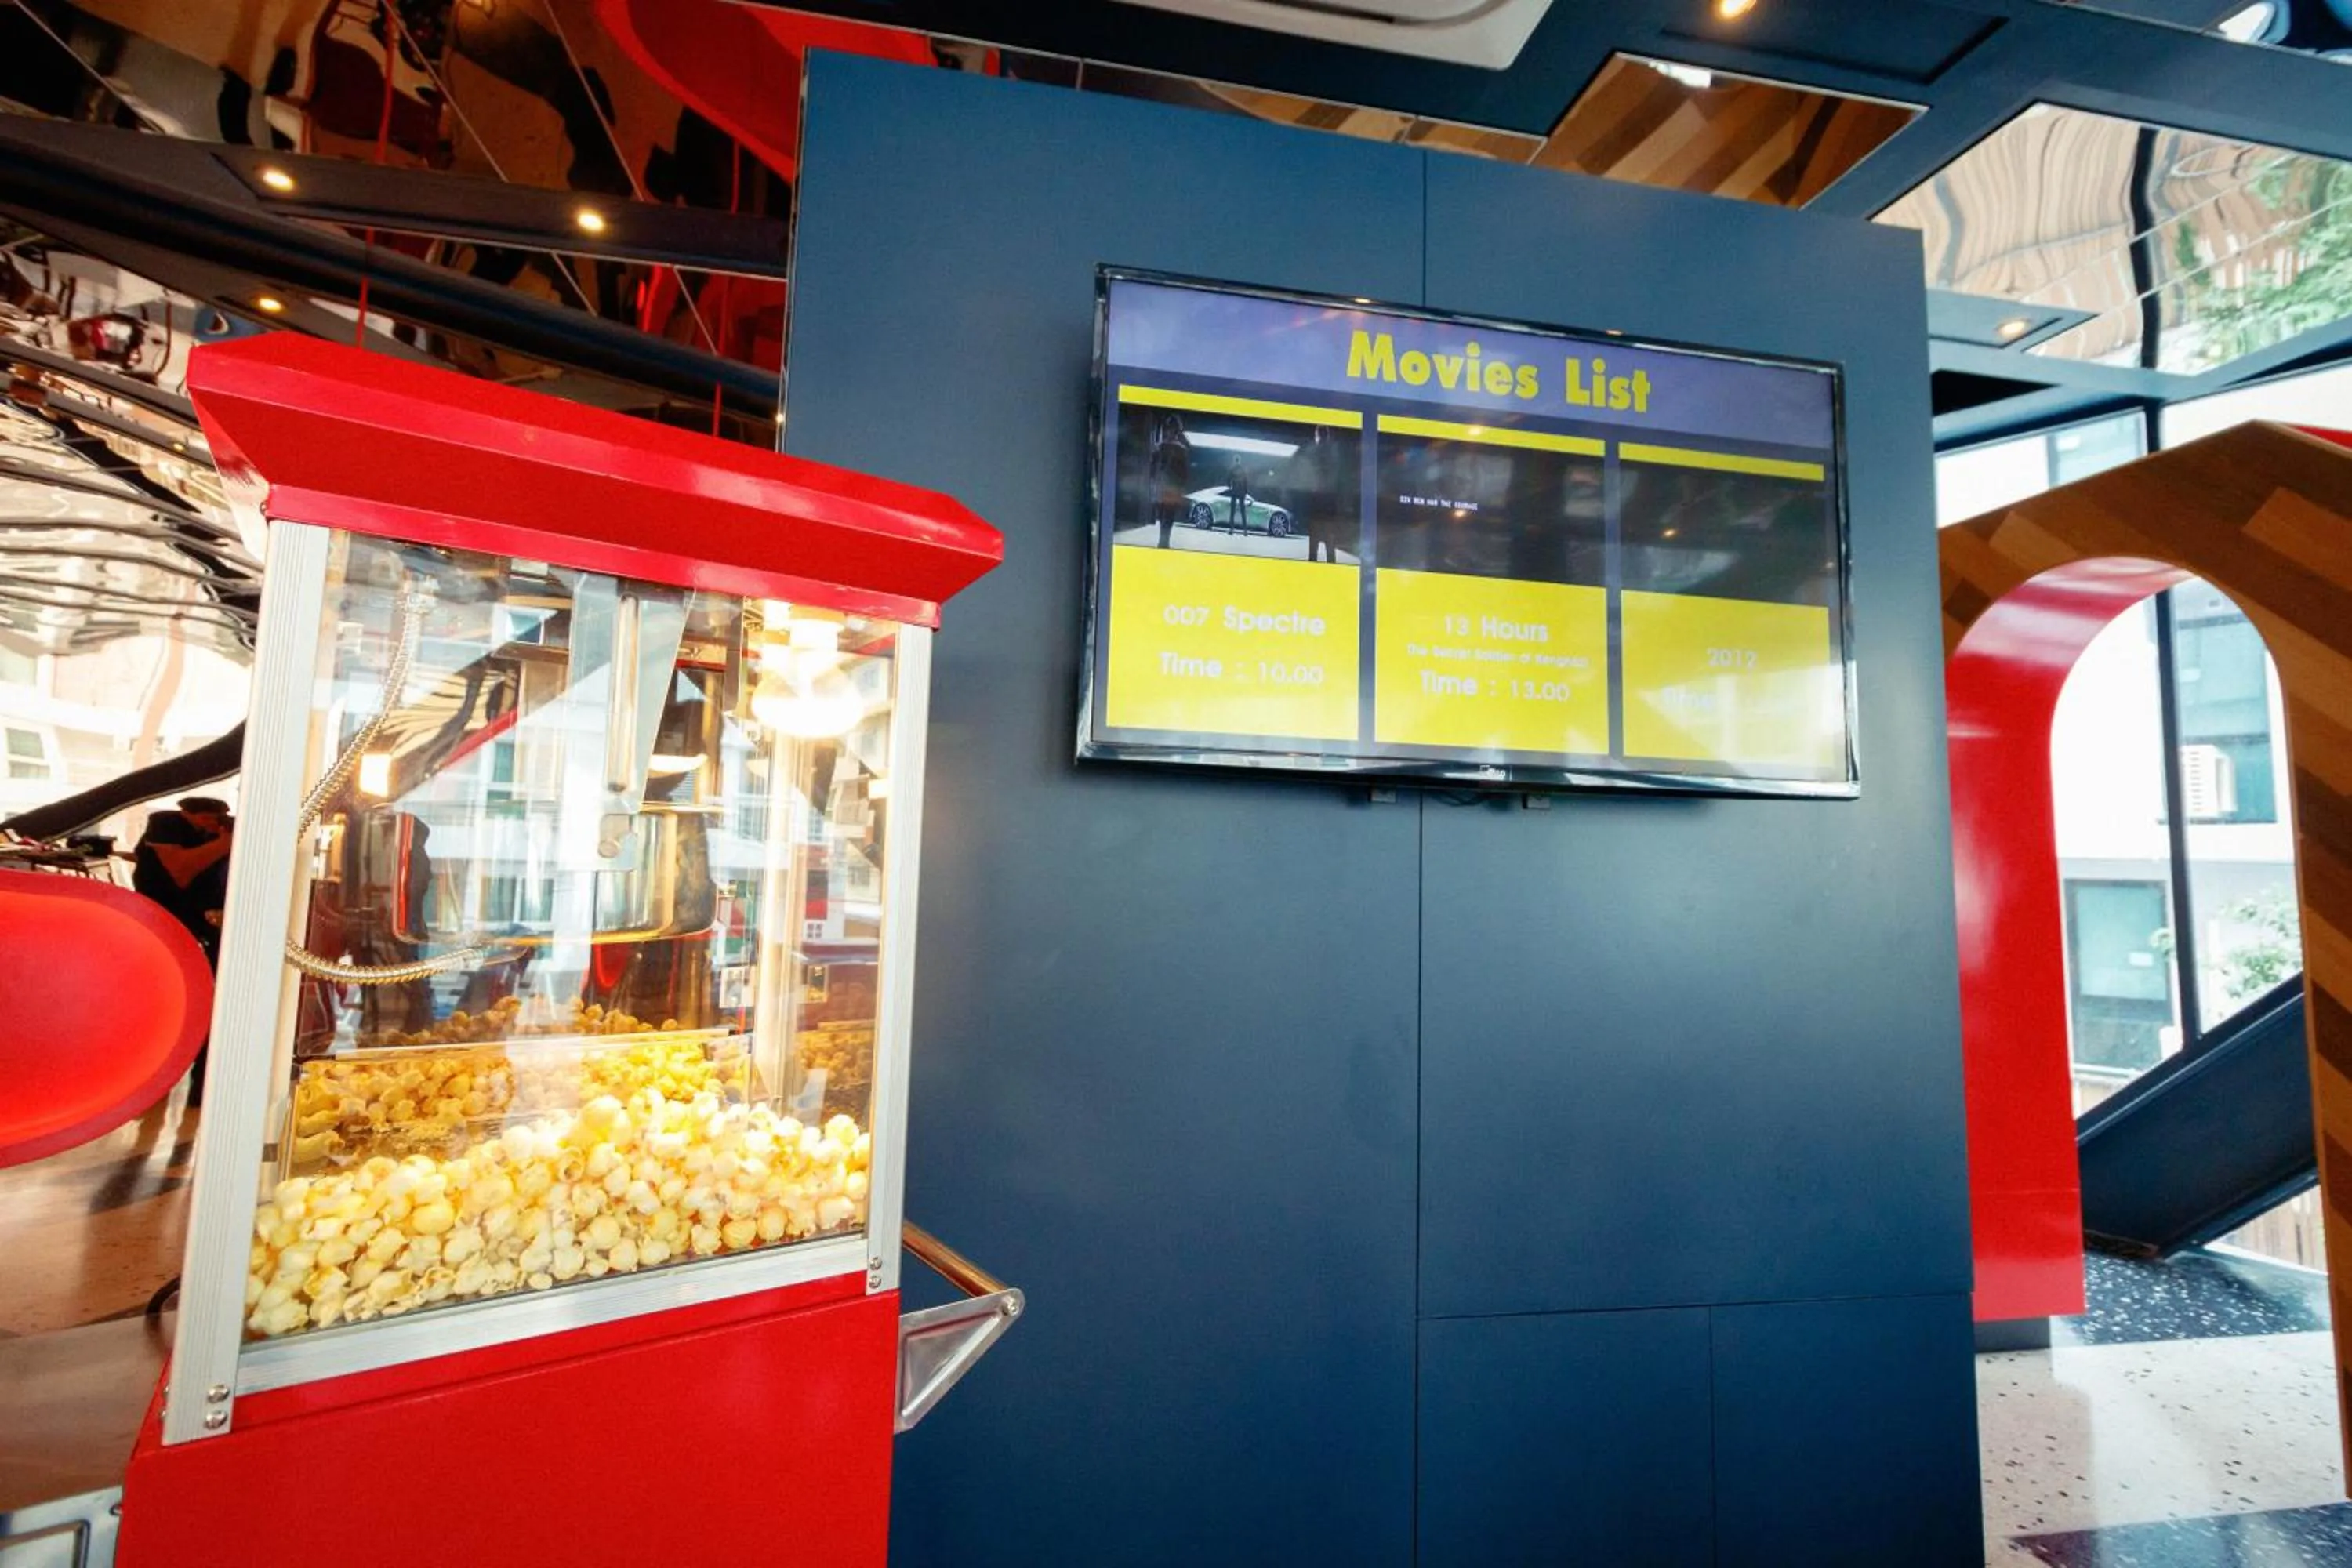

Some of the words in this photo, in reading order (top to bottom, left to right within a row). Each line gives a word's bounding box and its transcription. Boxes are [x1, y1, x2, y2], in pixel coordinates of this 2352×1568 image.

[1347, 329, 1539, 399] Movies
[1566, 357, 1651, 412] List
[1164, 604, 1209, 625] 007
[1225, 604, 1326, 635] Spectre
[1446, 615, 1468, 634] 13
[1482, 615, 1548, 641] Hours
[1160, 652, 1221, 677] Time
[1259, 662, 1323, 684] 10.00
[1707, 648, 1757, 666] 2012
[1421, 669, 1477, 695] Time
[1511, 681, 1570, 700] 13.00
